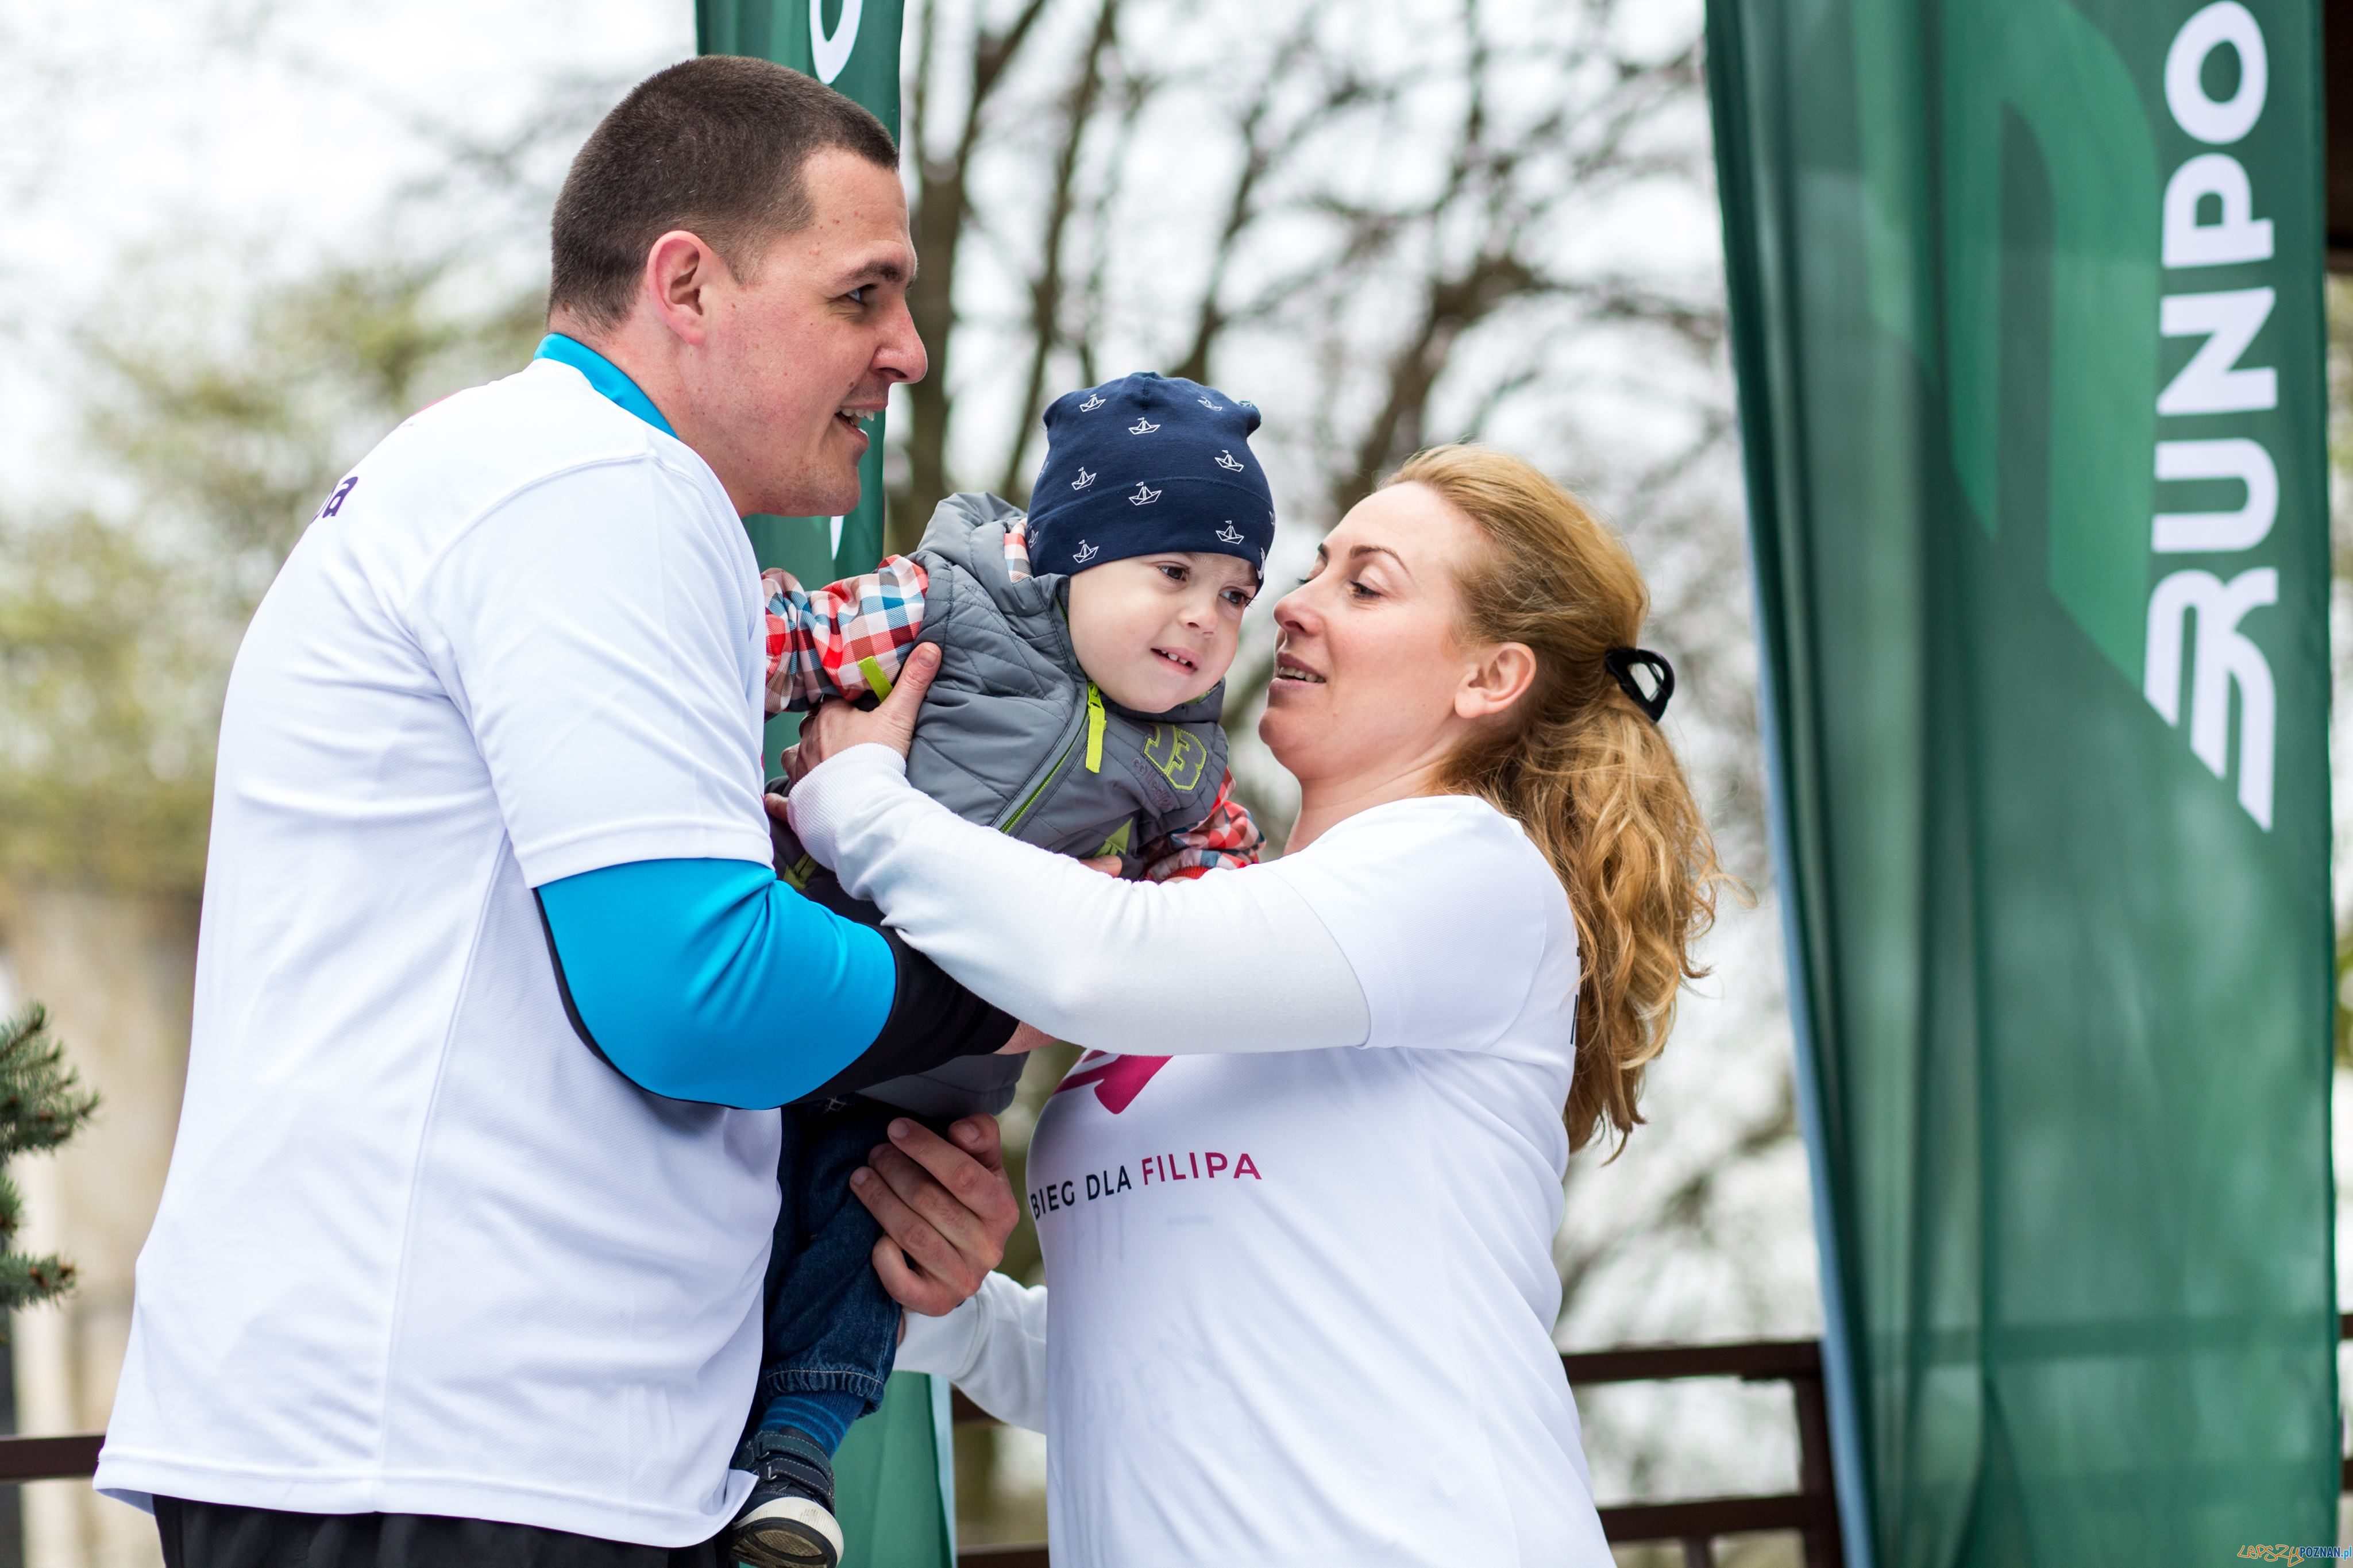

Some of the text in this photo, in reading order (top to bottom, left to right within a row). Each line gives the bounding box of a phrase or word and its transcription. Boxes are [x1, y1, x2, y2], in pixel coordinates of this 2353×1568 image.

[1030, 1152, 1262, 1221] BIEG DLA FILIPA
